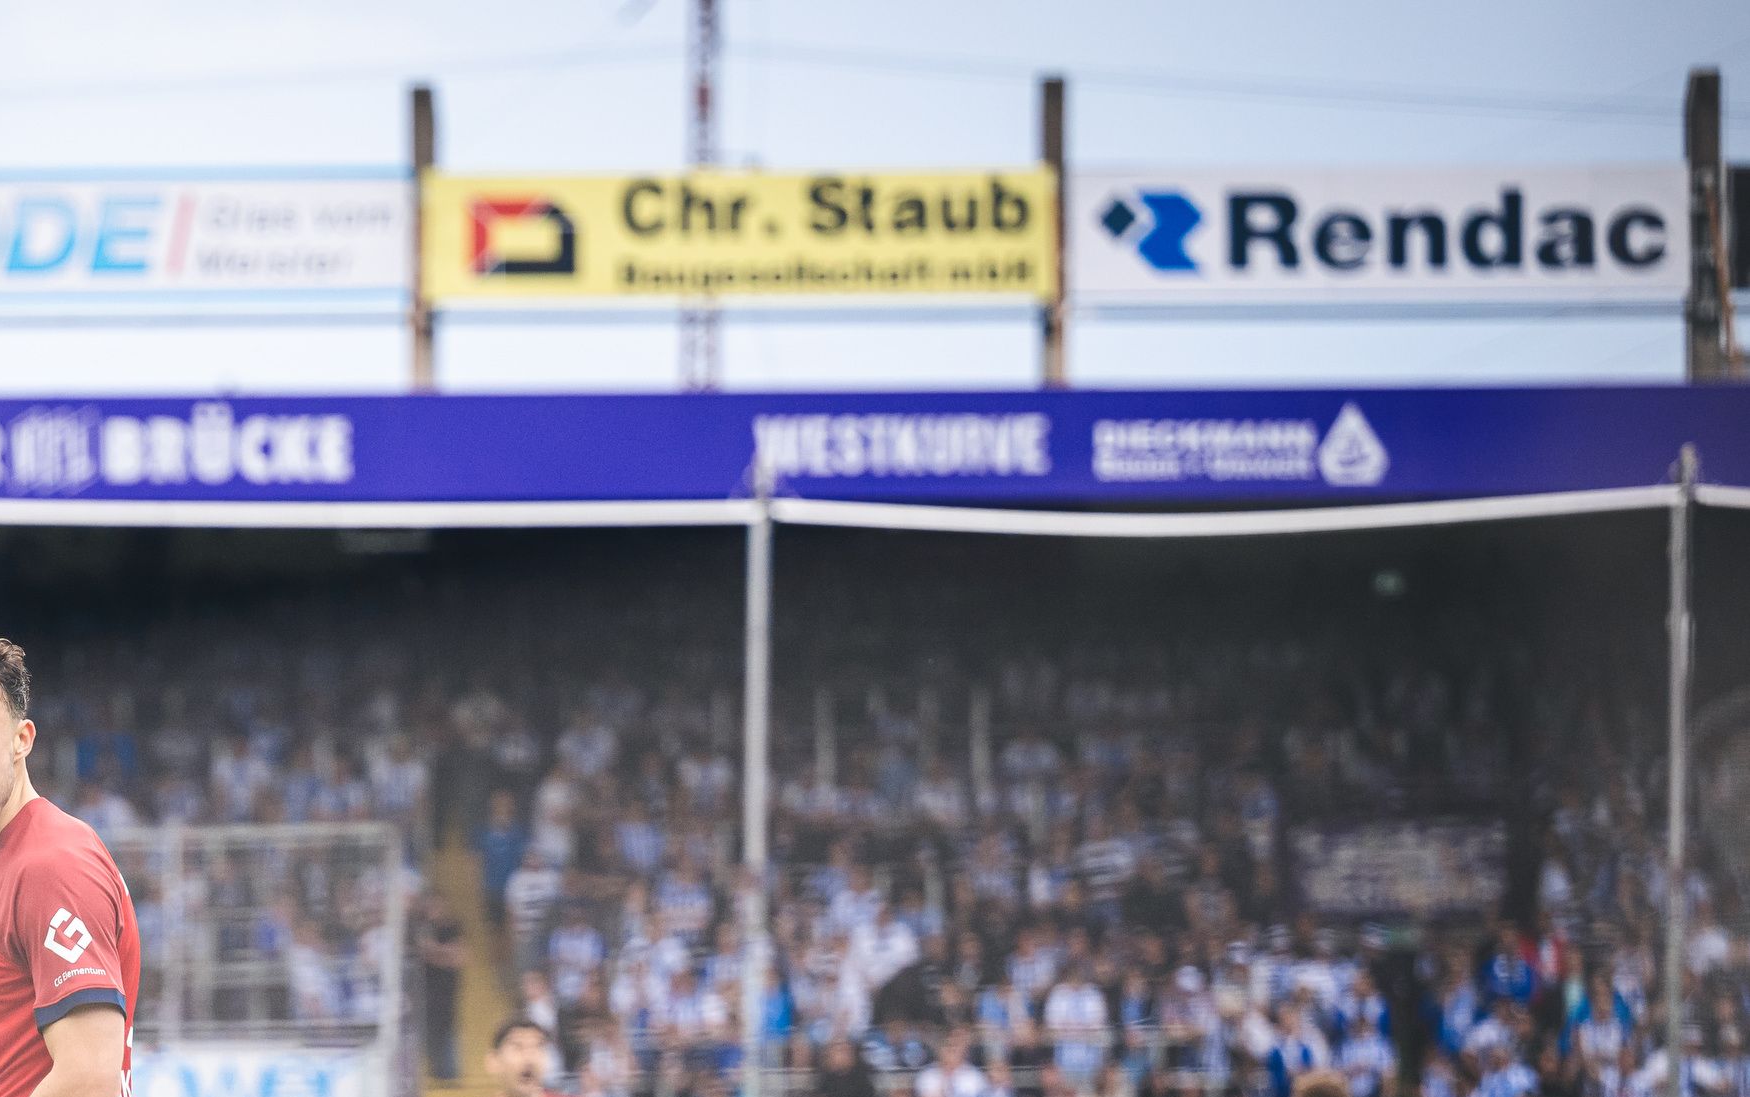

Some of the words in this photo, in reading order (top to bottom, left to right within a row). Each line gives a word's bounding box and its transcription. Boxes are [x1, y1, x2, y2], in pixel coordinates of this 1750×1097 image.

[620, 178, 780, 236] Chr.
[808, 176, 1030, 236] Staub
[1224, 188, 1667, 271] Rendac
[102, 404, 354, 484] BRÜCKE
[752, 412, 1050, 478] WESTKURVE
[62, 967, 107, 982] Elementum
